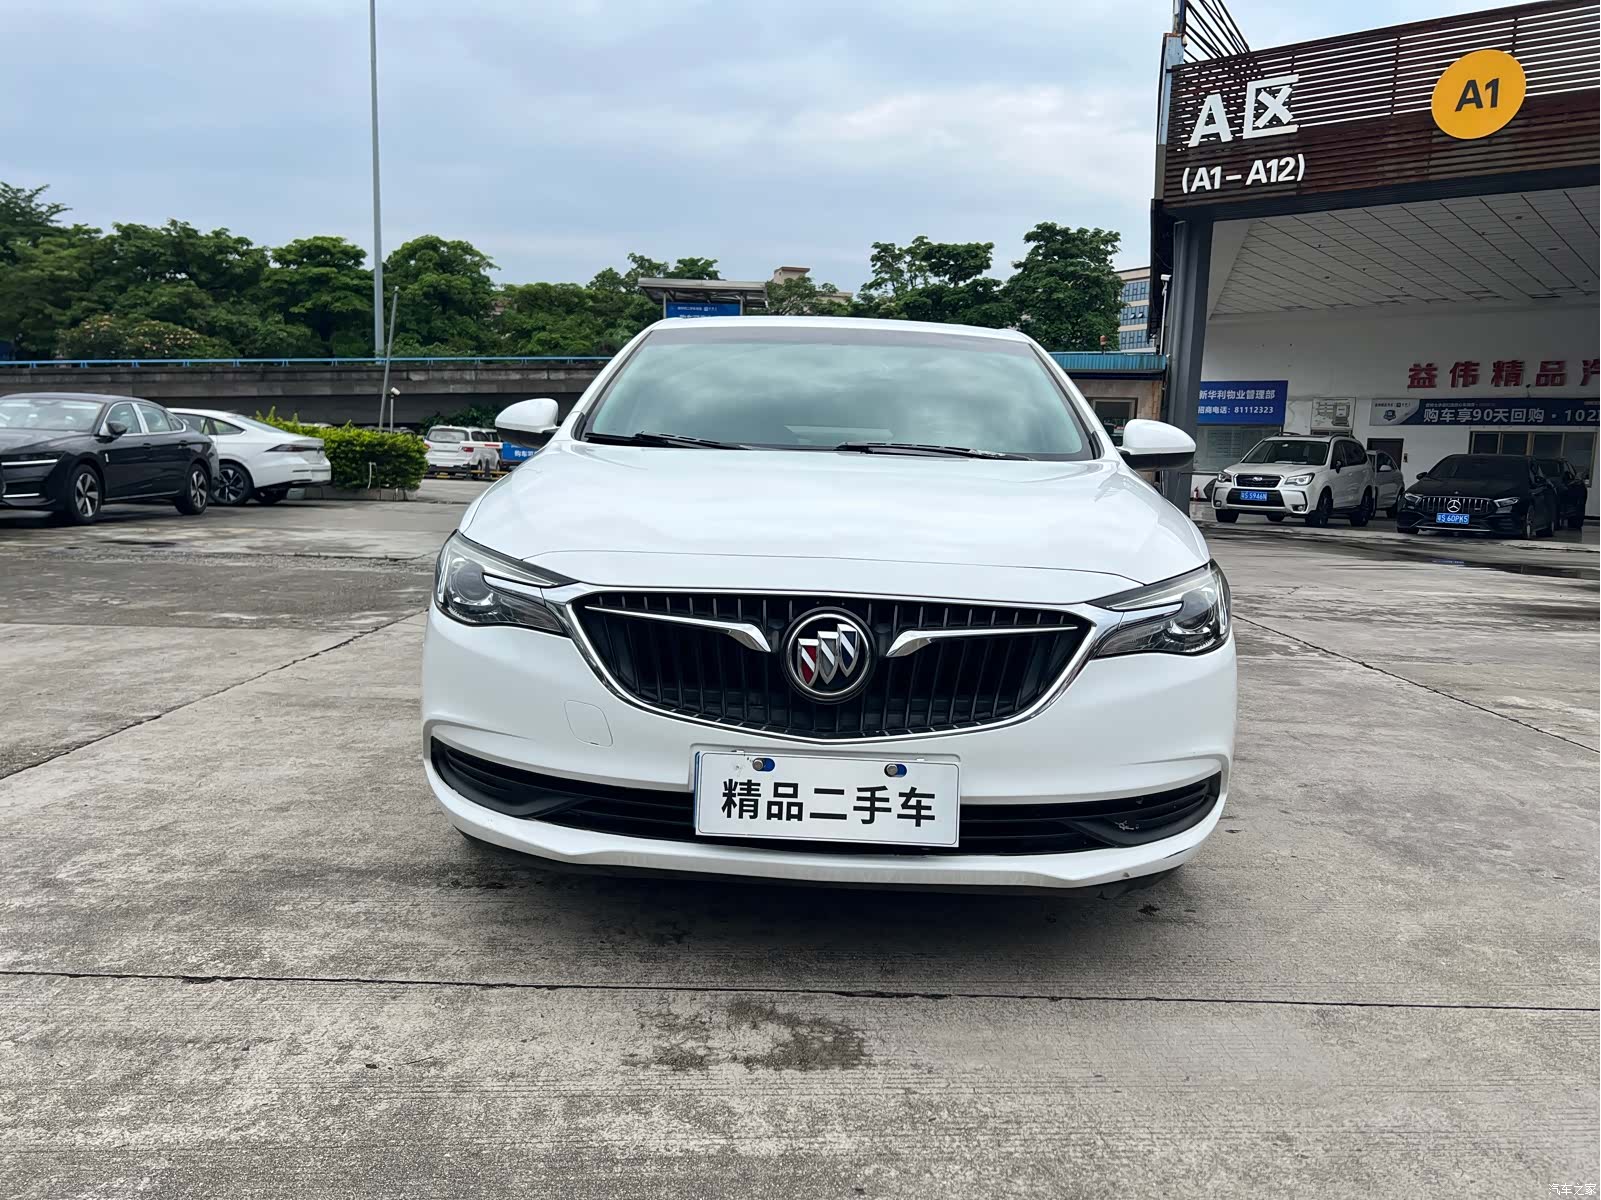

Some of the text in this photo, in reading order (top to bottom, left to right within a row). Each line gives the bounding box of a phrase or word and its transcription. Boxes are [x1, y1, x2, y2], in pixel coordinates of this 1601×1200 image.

[1188, 74, 1299, 147] A区
[1455, 78, 1500, 112] A1
[1199, 389, 1276, 400] 新华利物业管理部
[1423, 408, 1600, 423] 购车享90天回购·102
[721, 778, 936, 828] 精品二手车
